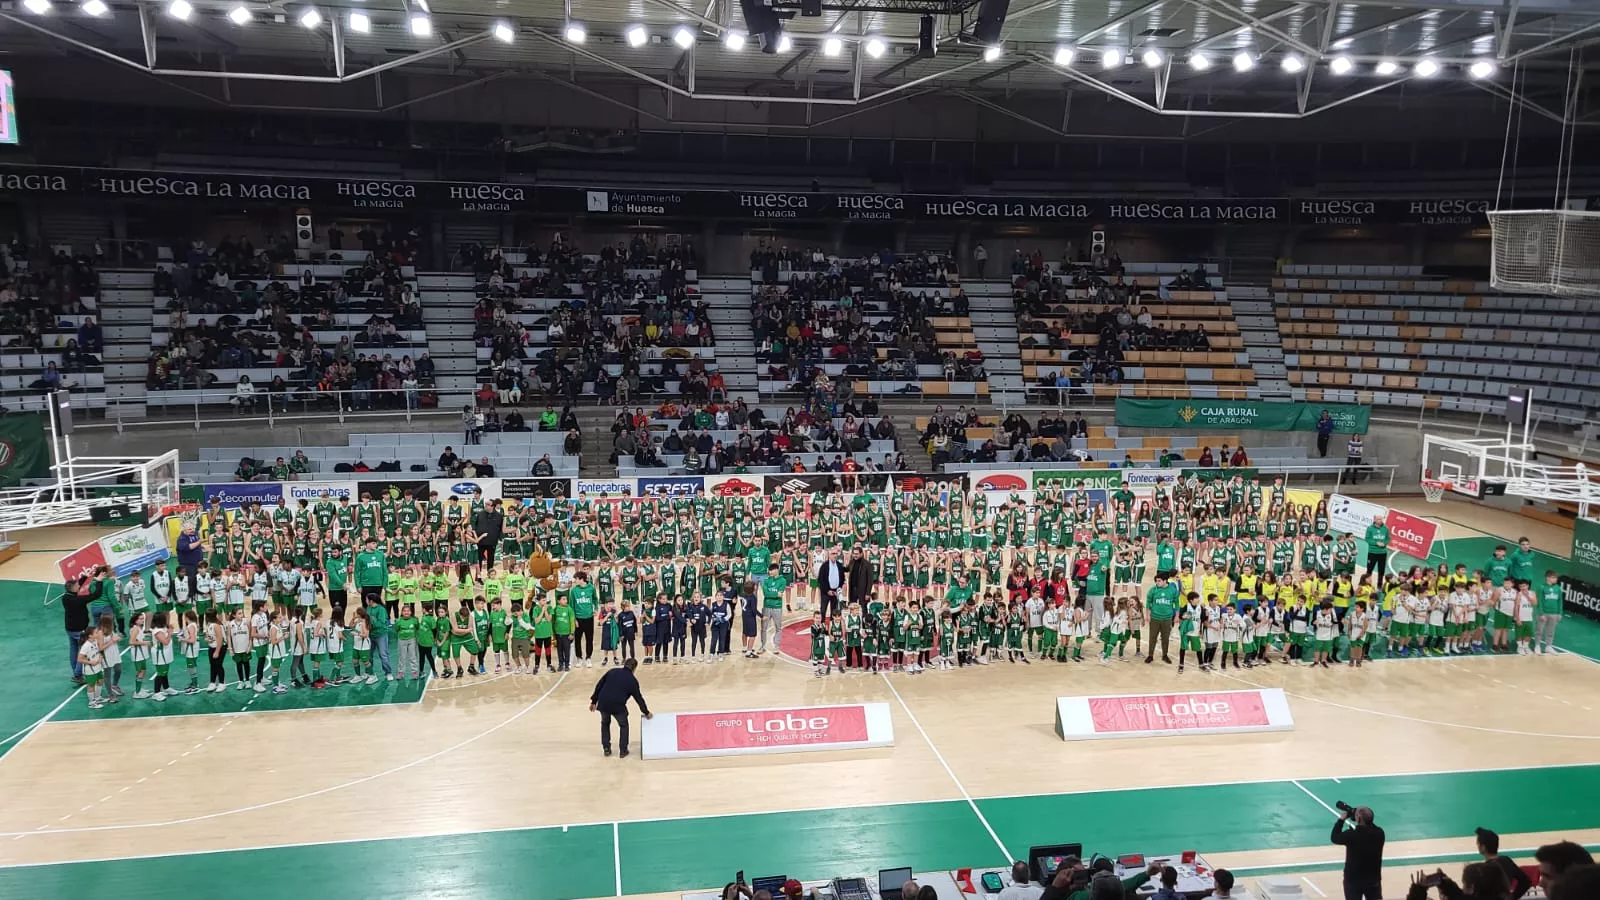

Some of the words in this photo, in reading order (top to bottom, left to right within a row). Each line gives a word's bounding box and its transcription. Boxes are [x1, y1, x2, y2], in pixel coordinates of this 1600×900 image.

[207, 184, 232, 197] La
[612, 191, 681, 204] Ayuntamiento
[612, 203, 624, 213] de
[627, 203, 665, 214] Huesca
[1004, 203, 1025, 217] La
[1189, 205, 1211, 218] La
[1201, 407, 1225, 416] CAJA
[1227, 407, 1259, 417] RURAL
[1341, 411, 1356, 421] San
[1220, 416, 1253, 424] ARAGÓN
[1128, 472, 1176, 483] Fontecaras
[577, 481, 632, 492] Fontecabras
[1391, 525, 1424, 545] Lobe
[1154, 698, 1230, 717] Lobe
[716, 719, 743, 728] GRUPO
[747, 713, 829, 733] Lobe
